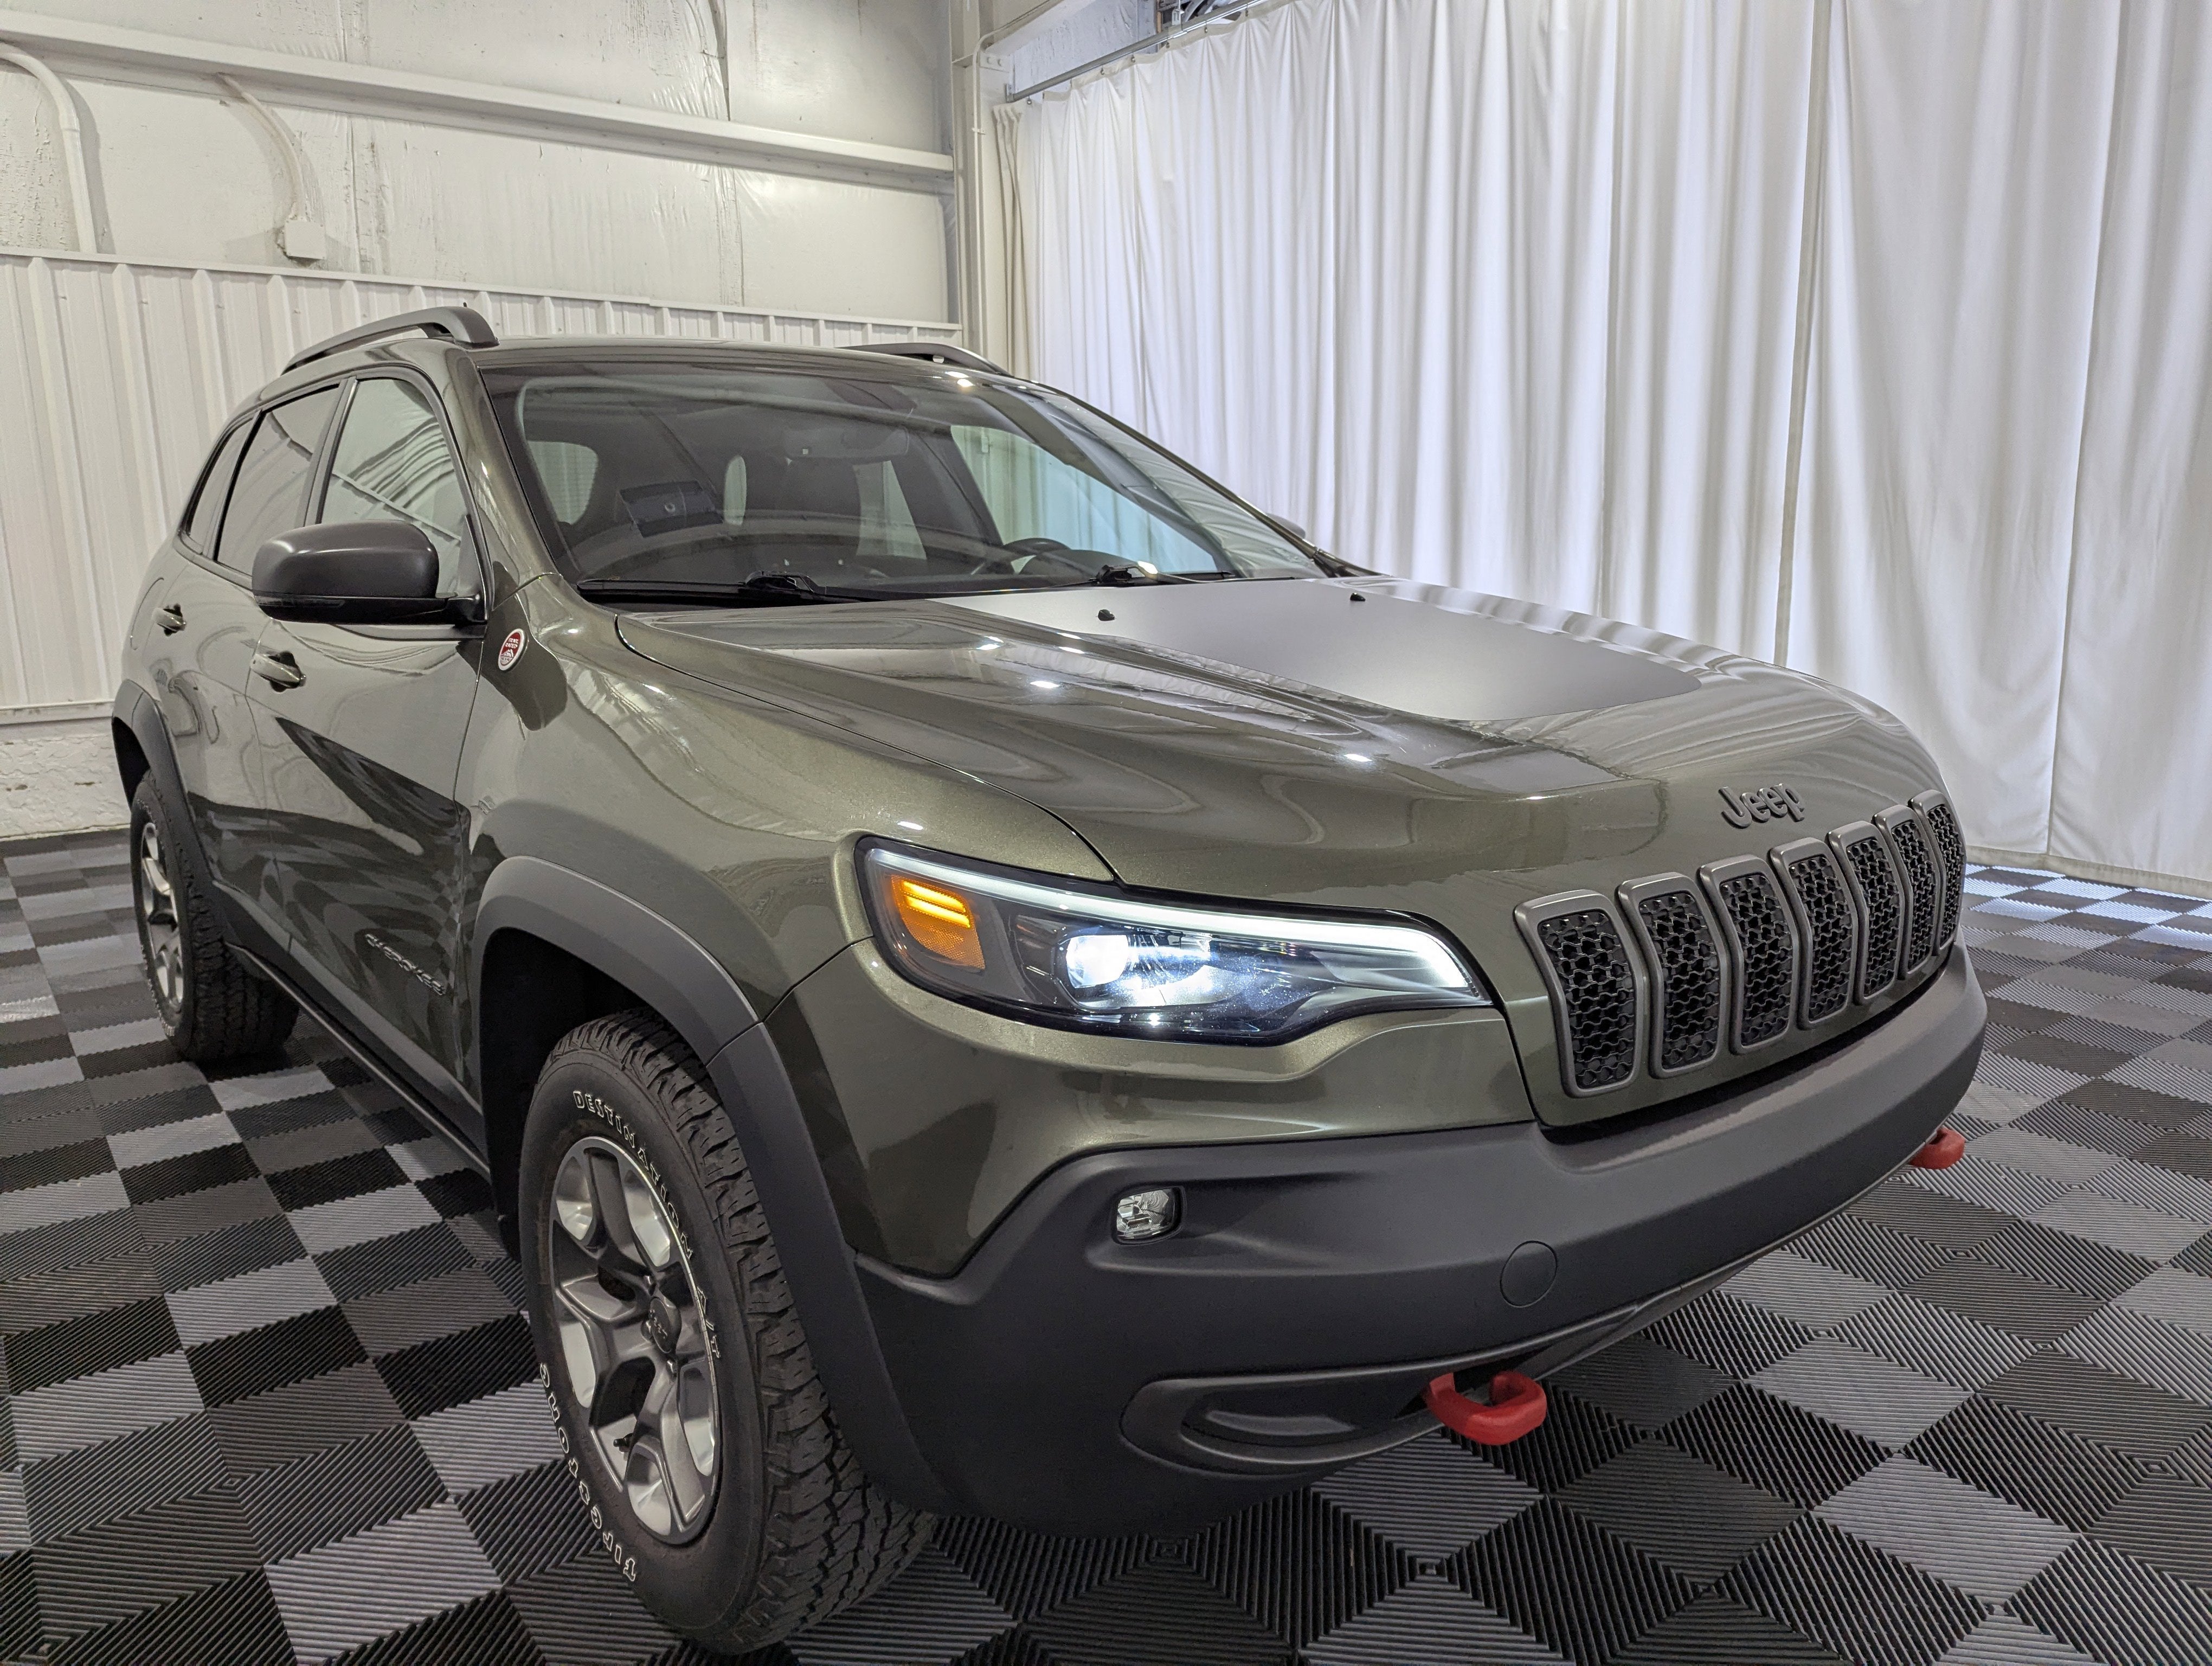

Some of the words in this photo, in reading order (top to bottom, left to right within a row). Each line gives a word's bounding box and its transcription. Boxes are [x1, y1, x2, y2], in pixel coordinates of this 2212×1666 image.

[1718, 783, 1805, 829] Jeep
[365, 934, 446, 995] CHEROKEE
[573, 1090, 693, 1260] DESTINATION
